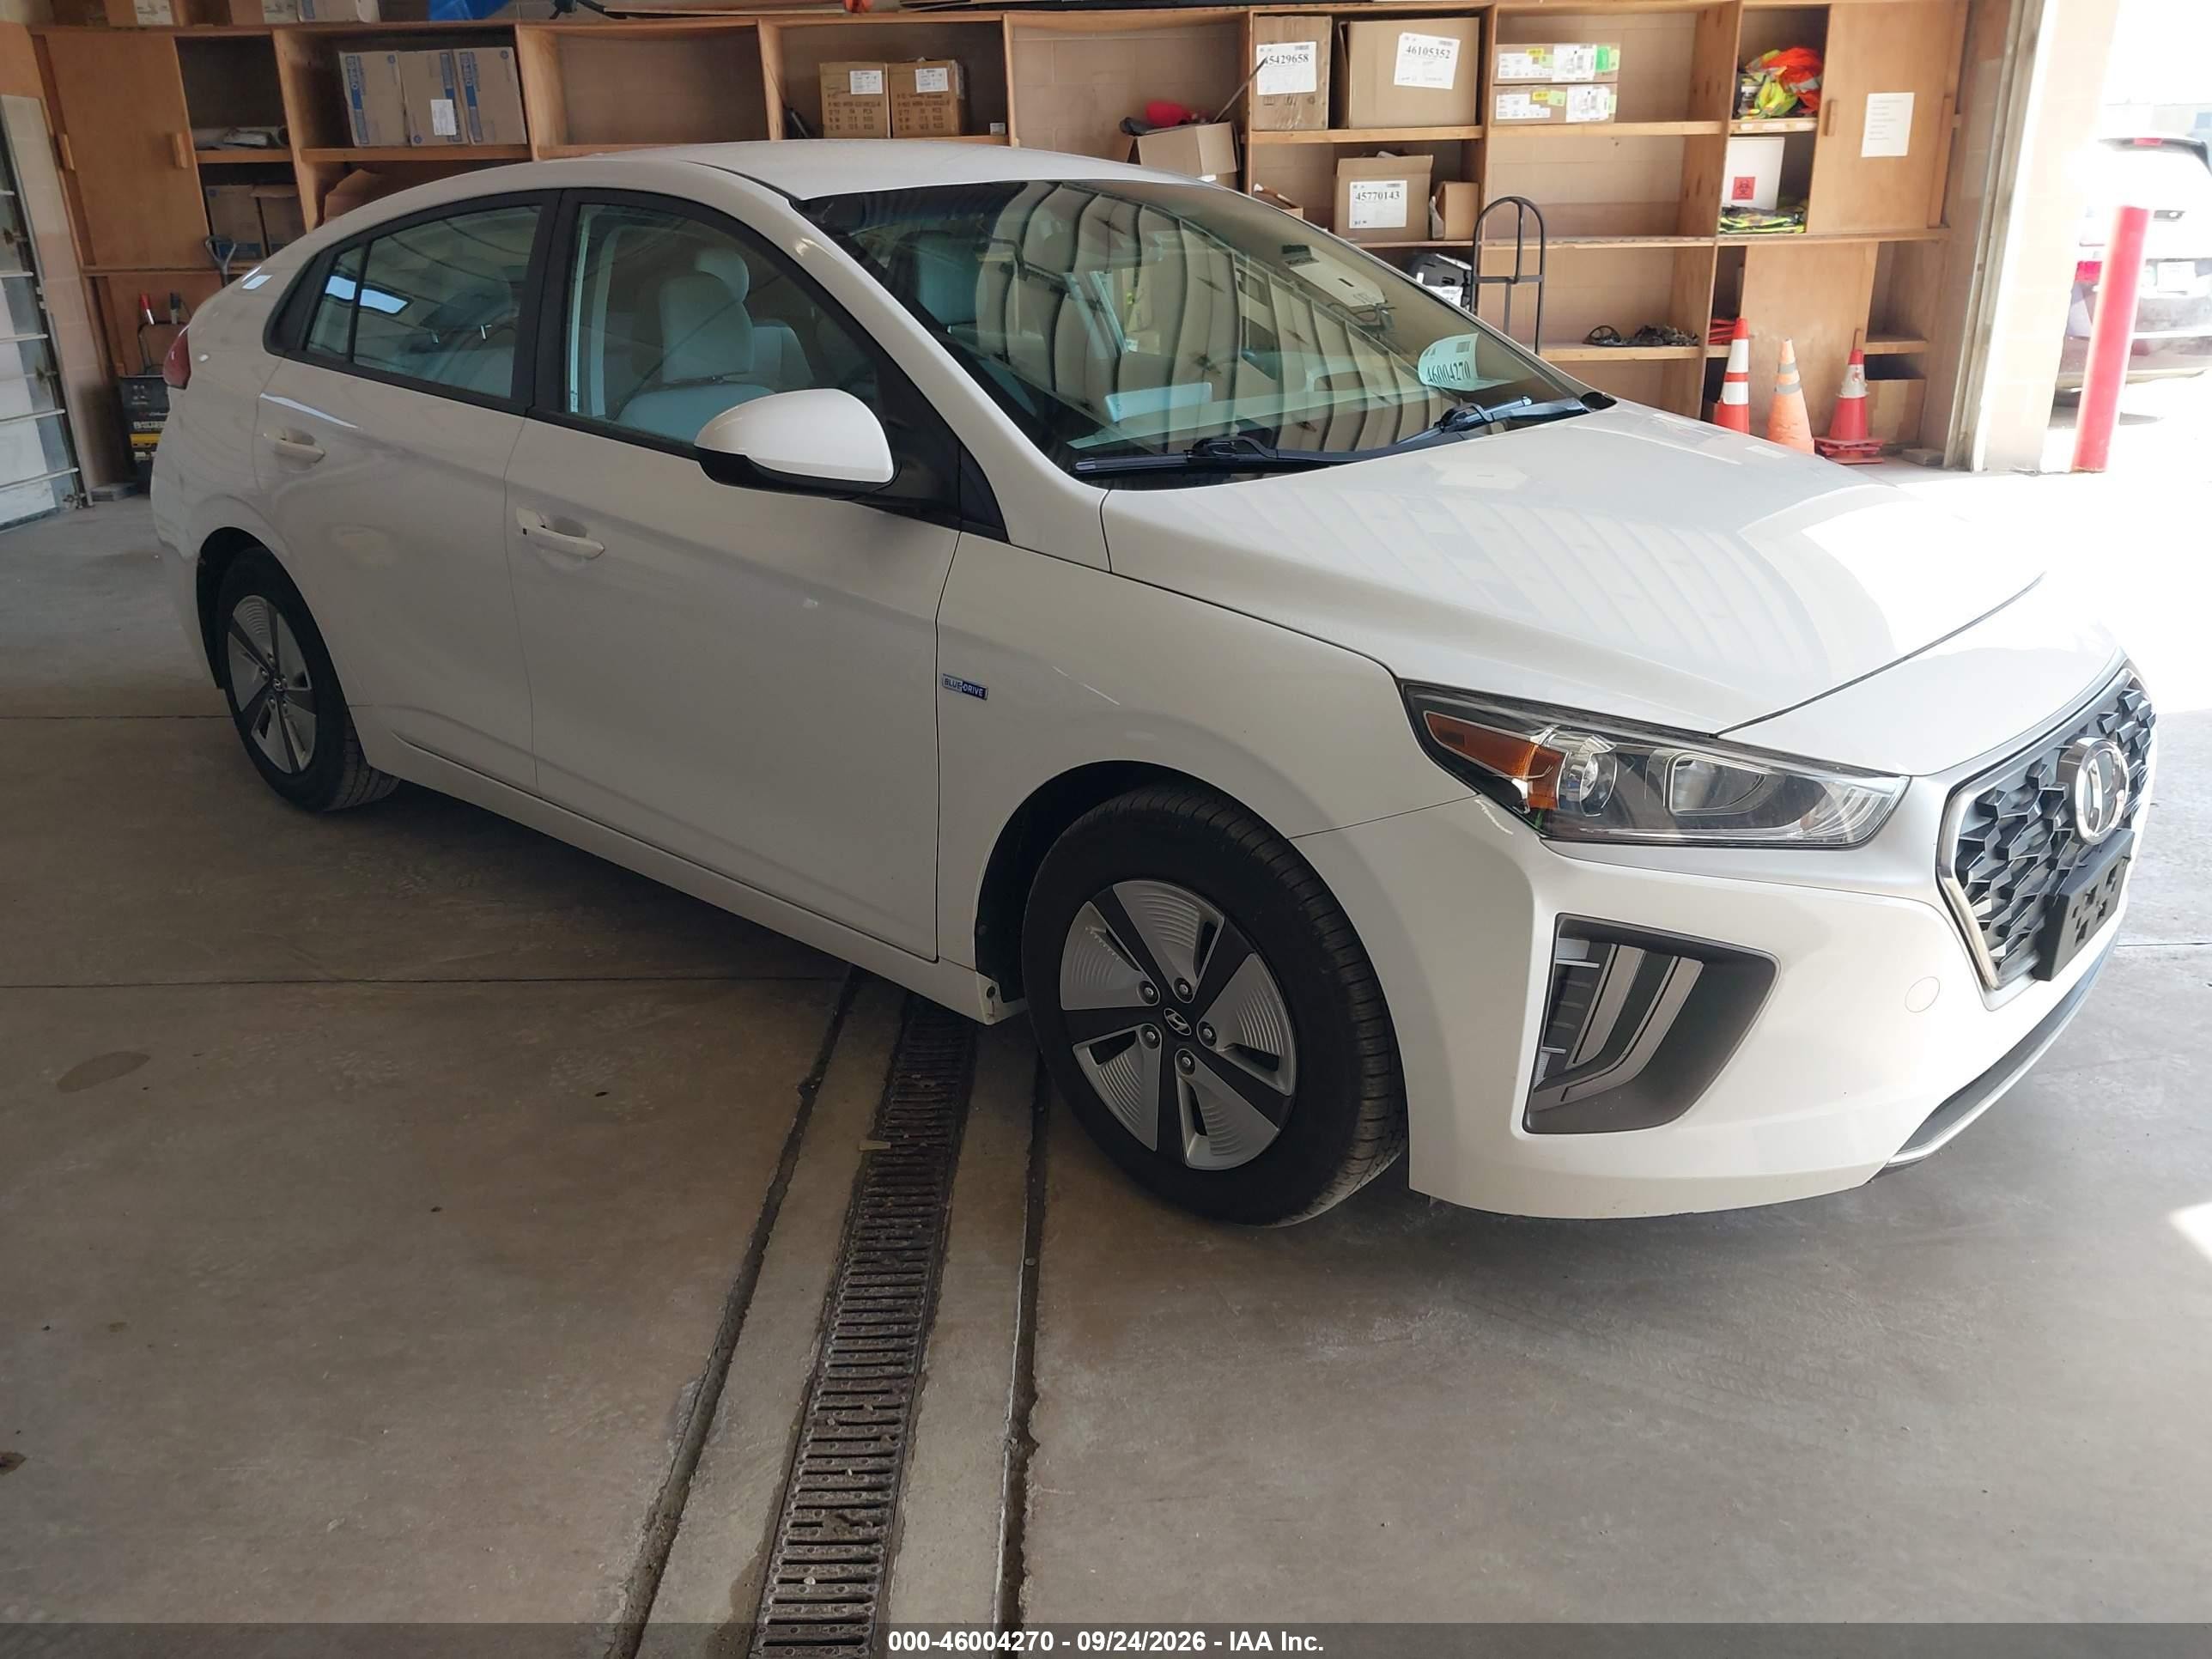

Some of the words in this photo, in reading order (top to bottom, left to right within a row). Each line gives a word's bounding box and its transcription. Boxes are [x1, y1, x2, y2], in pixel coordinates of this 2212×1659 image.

[1406, 45, 1451, 59] 46105352
[1355, 191, 1401, 202] 45770143
[1426, 360, 1471, 385] 46004270
